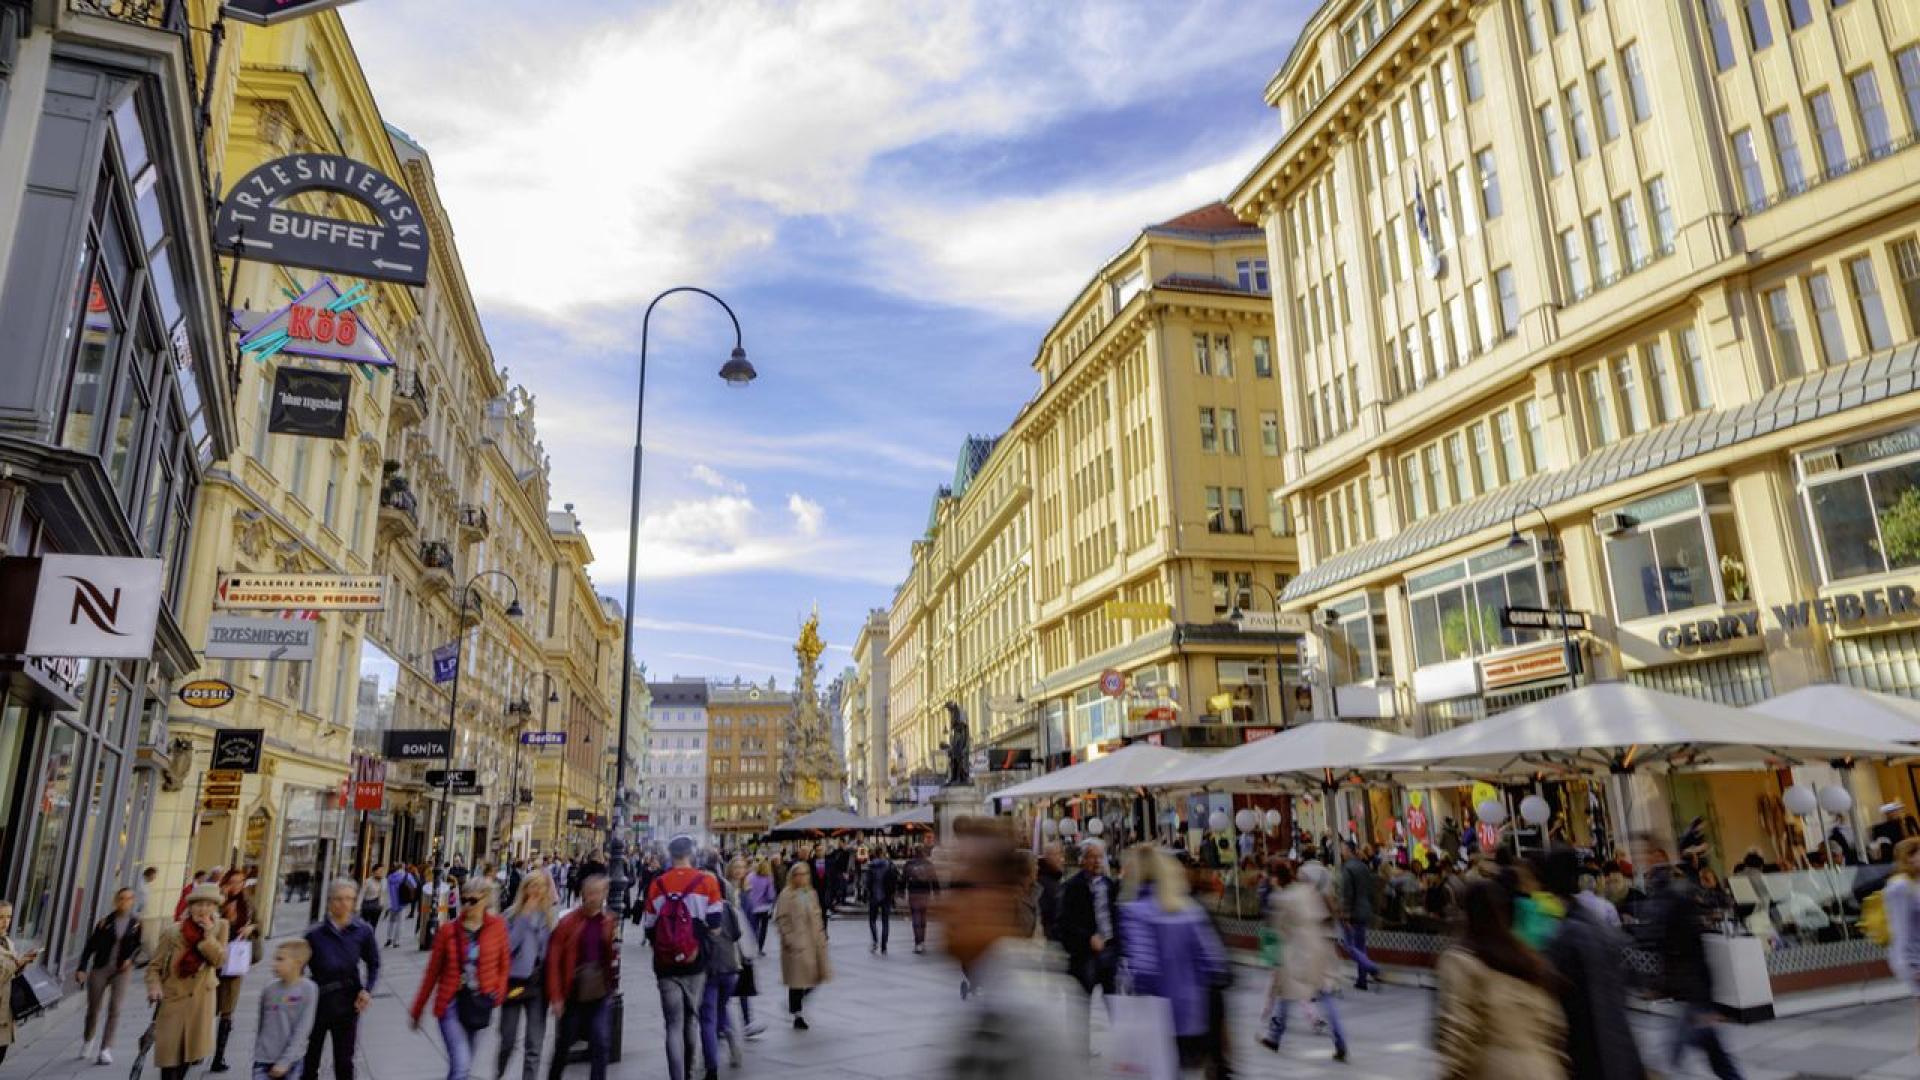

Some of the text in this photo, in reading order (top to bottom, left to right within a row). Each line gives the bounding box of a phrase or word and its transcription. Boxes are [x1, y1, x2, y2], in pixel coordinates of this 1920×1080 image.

[269, 213, 385, 250] BUFFET
[245, 578, 295, 587] GALERIE
[229, 593, 380, 603] SINDBADS REISEN
[1250, 616, 1301, 627] PANDORA
[1658, 583, 1918, 650] GERRY WEBER
[183, 688, 233, 698] FOSSIL
